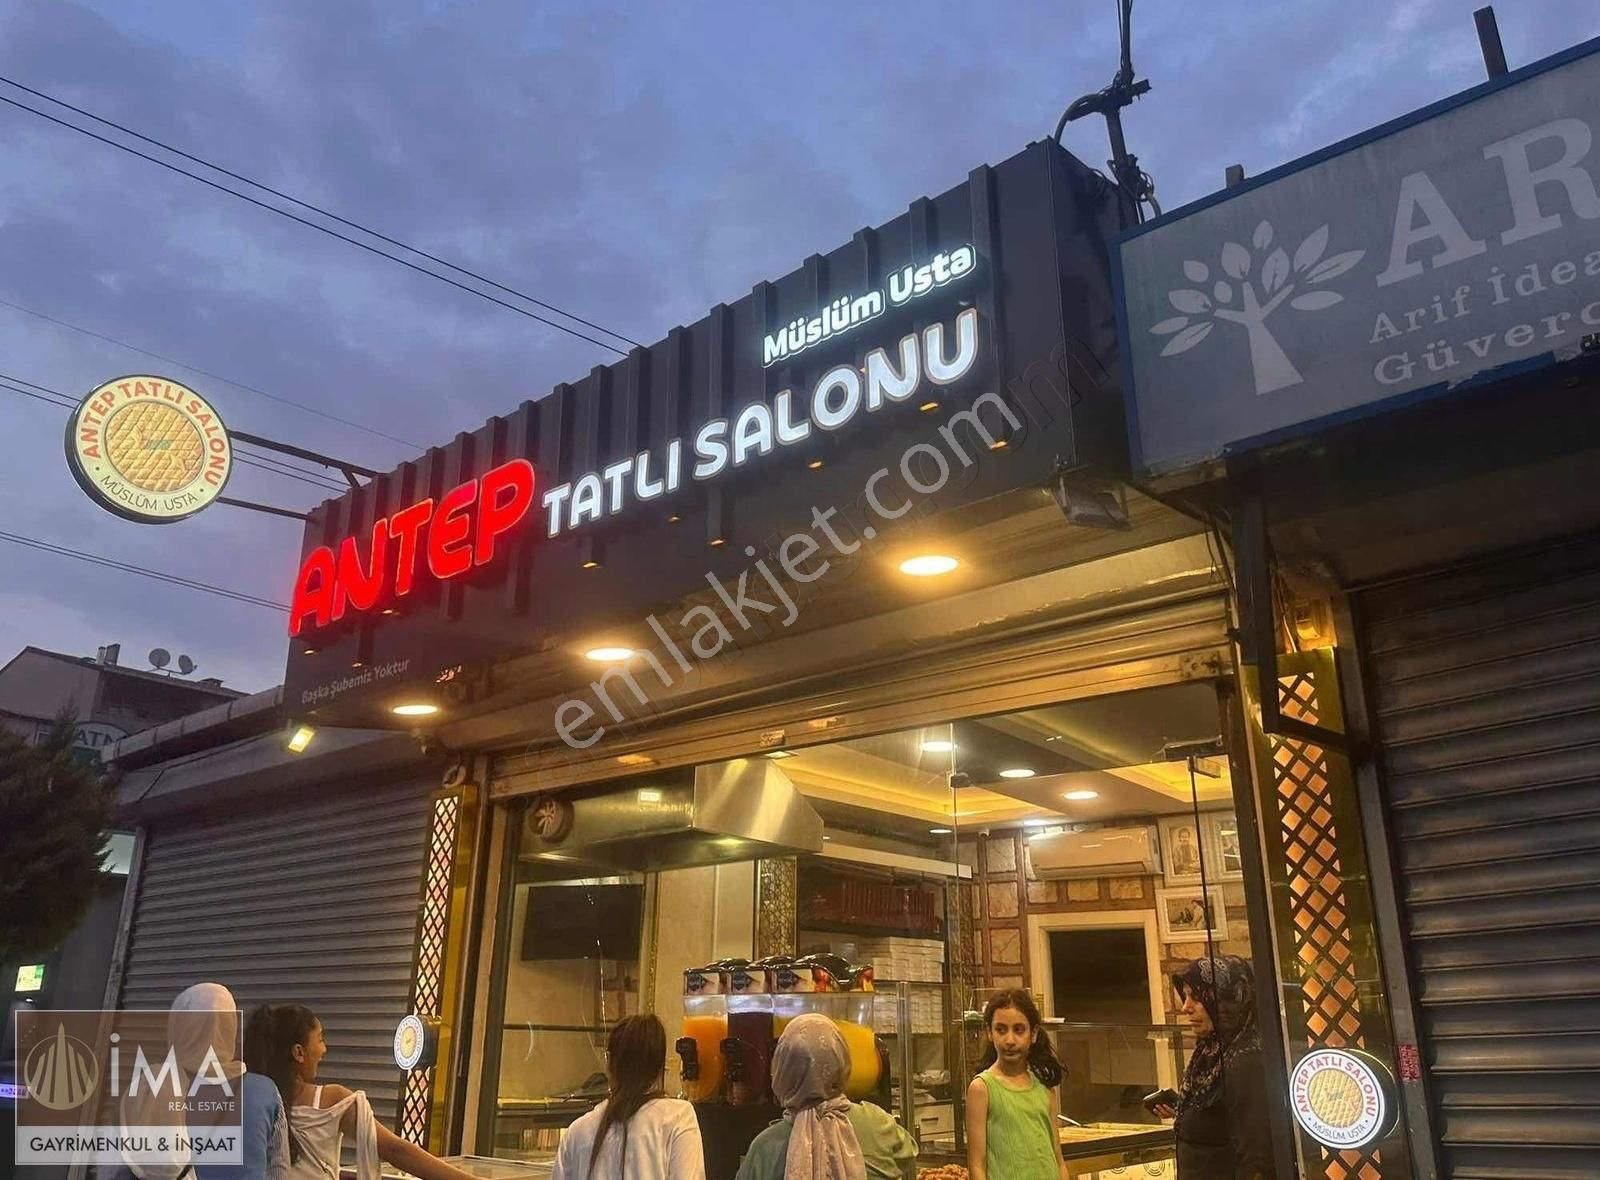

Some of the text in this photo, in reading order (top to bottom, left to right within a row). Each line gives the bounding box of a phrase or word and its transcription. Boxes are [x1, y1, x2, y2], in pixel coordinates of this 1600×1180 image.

[1375, 117, 1600, 288] AR
[762, 245, 976, 365] Müslüm Usta
[1369, 284, 1471, 344] Arif
[80, 381, 226, 486] ANTEP TATLI SALONU
[100, 475, 198, 511] MÜSLÜM USTA
[288, 308, 978, 637] ANTEP TATLI SALONU
[302, 659, 410, 704] Başka Şubemiz Yoktur
[1296, 1069, 1311, 1114] ANTEP
[1308, 1056, 1342, 1070] TATLI
[1344, 1061, 1377, 1117] SALONU
[1347, 1123, 1367, 1139] USTA
